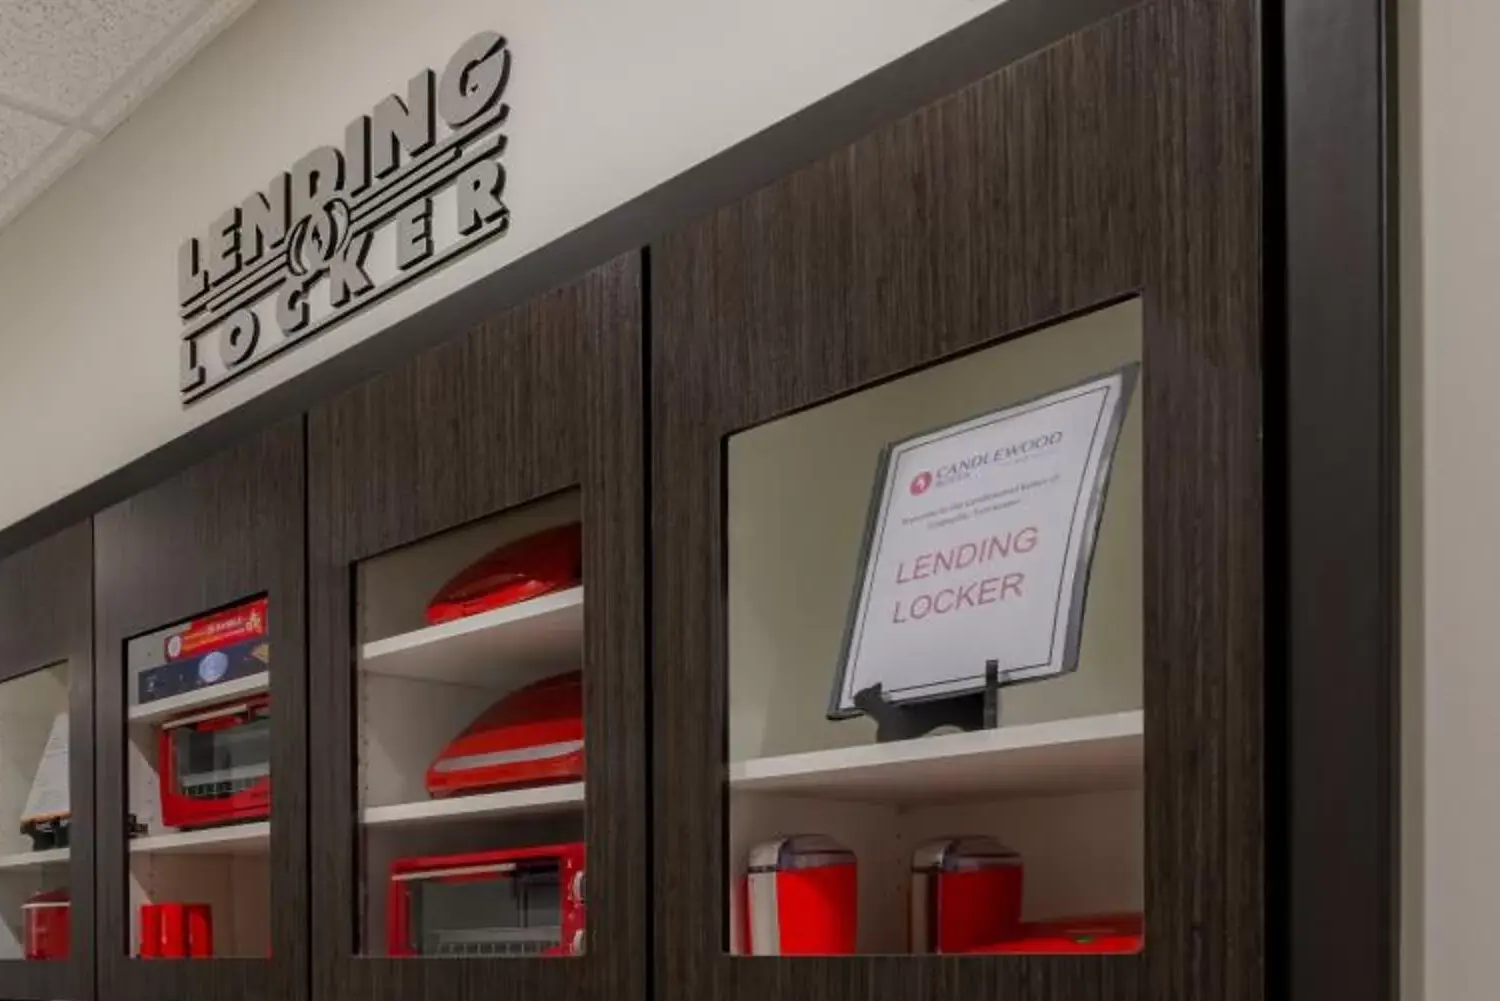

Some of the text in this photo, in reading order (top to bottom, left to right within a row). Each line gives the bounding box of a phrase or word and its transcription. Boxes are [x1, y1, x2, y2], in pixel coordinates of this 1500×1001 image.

[178, 30, 512, 308] LENDING
[179, 160, 511, 394] LOCKER
[936, 430, 1064, 480] CANDLEWOOD
[895, 526, 1039, 584] LENDING
[892, 571, 1026, 624] LOCKER
